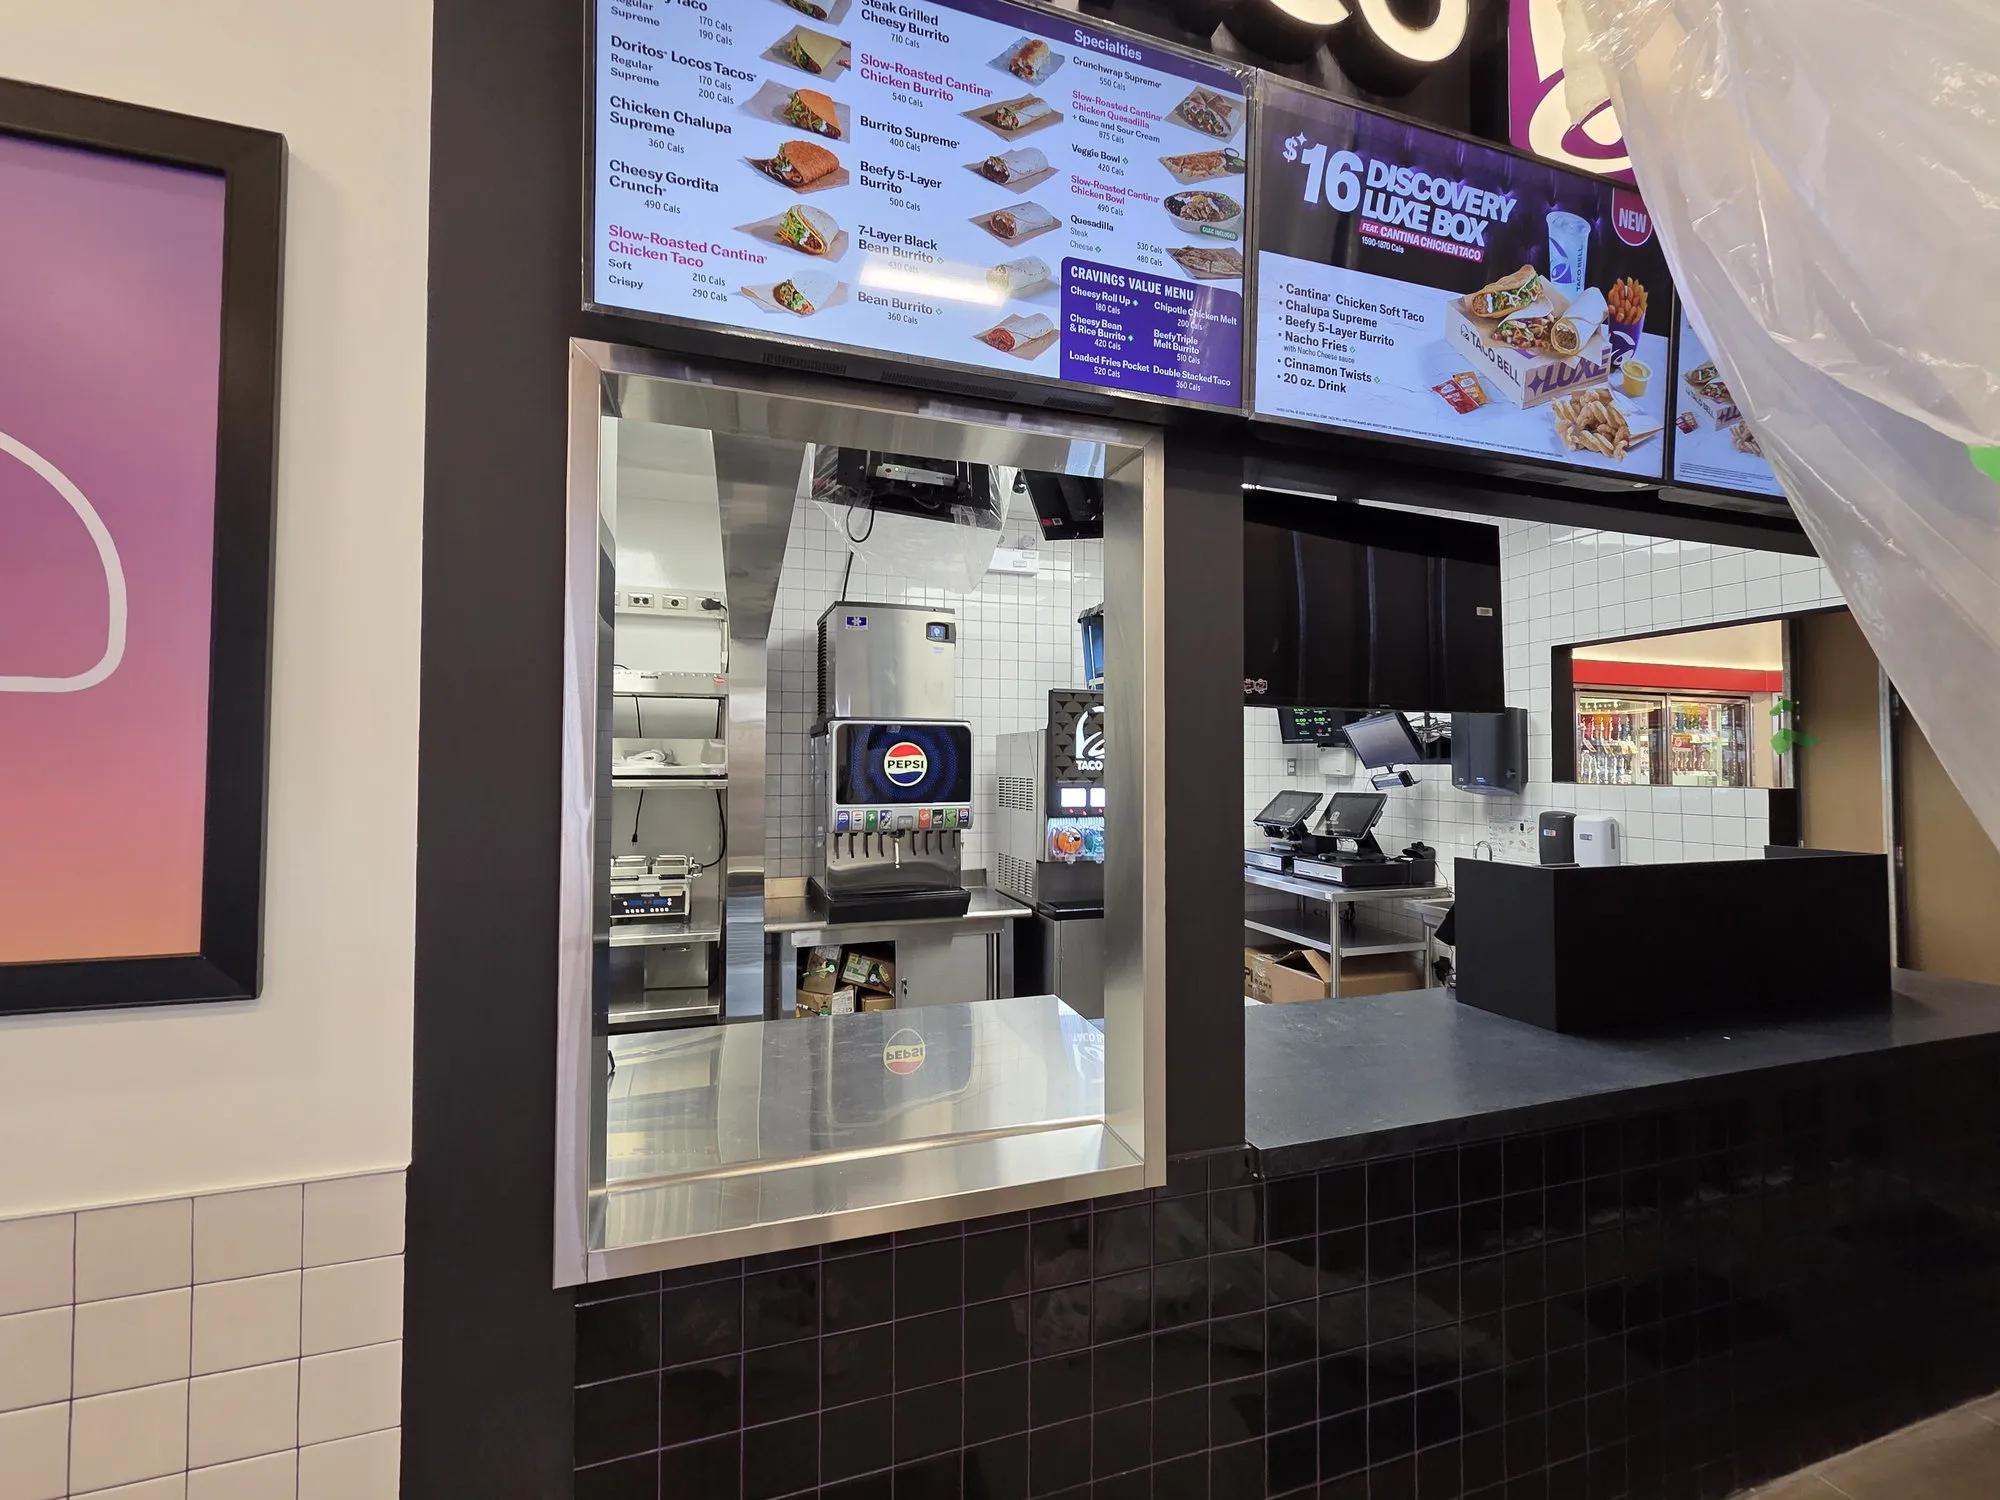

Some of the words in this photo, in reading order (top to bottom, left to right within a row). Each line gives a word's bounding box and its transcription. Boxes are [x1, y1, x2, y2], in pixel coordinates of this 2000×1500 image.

[611, 6, 660, 27] Supreme
[861, 0, 897, 14] Steak
[899, 6, 939, 26] Grilled
[700, 16, 713, 27] 170
[715, 21, 732, 32] Cals
[862, 9, 906, 32] Cheesy
[909, 22, 949, 43] Burrito
[700, 30, 713, 40] 190
[716, 34, 733, 46] Cals
[891, 33, 903, 43] 710
[905, 38, 920, 48] Cals
[1074, 29, 1142, 61] Specialties
[611, 53, 653, 72] Regular
[672, 51, 712, 71] Locos
[861, 53, 943, 85] Slow-Roasted
[1073, 56, 1123, 79] Crunchwrap
[611, 67, 659, 87] Supreme
[699, 76, 712, 87] 170
[715, 80, 732, 91] Cals
[861, 68, 909, 90] Chicken
[913, 82, 954, 102] Burrito
[699, 88, 714, 99] 200
[718, 94, 734, 105] Cals
[893, 93, 906, 103] 540
[909, 97, 923, 108] Cals
[1072, 91, 1128, 113] Slow-Roasted
[610, 95, 669, 120] Chicken
[674, 110, 732, 134] Chalupa
[610, 111, 675, 136] Supreme
[1072, 102, 1106, 118] Chicken
[1107, 111, 1150, 129] Quesadilla
[861, 116, 902, 135] Burrito
[1079, 115, 1099, 127] Guac
[1101, 120, 1115, 130] and
[1117, 125, 1134, 137] Sour
[1136, 130, 1160, 144] Cream
[648, 138, 665, 149] 360
[668, 143, 684, 154] Cals
[890, 138, 904, 148] 400
[906, 142, 920, 152] Cals
[1072, 144, 1099, 159] Veggie
[1101, 151, 1120, 164] Bowl
[610, 160, 663, 182] Cheesy
[666, 172, 719, 193] Gordita
[861, 161, 895, 180] Beefy
[898, 170, 942, 189] 5-Layer
[861, 175, 902, 193] Burrito
[1071, 175, 1126, 195] Slow-Roasted
[1071, 186, 1105, 200] Chicken
[1106, 193, 1125, 205] Bowl
[1367, 159, 1517, 223] DISCOVERY
[644, 200, 660, 210] 490
[664, 204, 680, 214] Cals
[890, 198, 903, 208] 500
[906, 202, 920, 212] Cals
[1071, 215, 1114, 232] Quesadilla
[1362, 190, 1430, 232] LUXE
[1432, 208, 1488, 247] BOX
[1619, 208, 1646, 233] NEW
[609, 225, 707, 254] Slow-Roasted
[858, 225, 902, 243] 7-Layer
[905, 234, 937, 250] Black
[1070, 228, 1088, 238] Steak
[1362, 223, 1378, 234] FEAT.
[1381, 227, 1421, 246] CANTINA
[1421, 235, 1459, 255] CHICKEN
[1459, 246, 1481, 261] TACO
[609, 241, 668, 261] Chicken
[671, 251, 704, 268] Taco
[858, 239, 889, 255] Bean
[893, 246, 933, 263] Burrito
[1070, 240, 1093, 251] Cheese
[1362, 236, 1390, 251] 1590-1870
[1392, 244, 1404, 254] Cals
[608, 259, 632, 270] Soft
[609, 275, 643, 289] Crispy
[693, 273, 706, 283] 210
[709, 277, 725, 286] Cals
[1071, 266, 1125, 287] CRAVINGS
[1129, 278, 1161, 295] VALUE
[1165, 285, 1194, 301] MENU
[693, 289, 708, 299] 290
[711, 292, 728, 302] Cals
[858, 292, 888, 306] Bean
[892, 298, 933, 315] Burrito
[1071, 285, 1101, 301] Cheesy
[1102, 292, 1118, 302] Roll
[1119, 295, 1131, 306] Up
[888, 312, 901, 322] 360
[904, 315, 918, 324] Cals
[1154, 302, 1187, 316] Chipotle
[1188, 309, 1219, 322] Chicken
[1221, 314, 1237, 325] Melt
[1286, 300, 1329, 318] Chalupa
[1333, 309, 1377, 328] Supreme
[1336, 294, 1377, 312] Chicken
[1380, 304, 1401, 318] Soft
[1402, 309, 1425, 323] Taco
[1070, 314, 1101, 328] Cheesy
[1102, 319, 1122, 331] Bean
[1070, 324, 1076, 332] &
[1078, 326, 1096, 336] Rice
[1098, 329, 1126, 341] Burrito
[1285, 315, 1316, 332] Beefy
[1319, 322, 1357, 339] 5-Layer
[1360, 330, 1395, 347] Burrito
[1154, 330, 1177, 342] Beefy
[1177, 335, 1198, 345] Triple
[1154, 339, 1172, 350] Melt
[1173, 343, 1199, 355] Burrito
[1285, 331, 1319, 347] Nacho
[1322, 338, 1347, 353] Fries
[1069, 351, 1099, 365] Loaded
[1101, 357, 1121, 368] Fries
[1123, 360, 1150, 373] Pocket
[1284, 345, 1297, 353] with
[1298, 347, 1316, 357] Nacho
[1317, 350, 1338, 361] Cheese
[1339, 355, 1355, 364] sauce
[1470, 331, 1496, 363] TACO
[1496, 354, 1521, 387] BELL
[1153, 366, 1181, 378] Double
[1182, 371, 1212, 383] Stacked
[1213, 376, 1231, 387] Taco
[1285, 357, 1338, 377] Cinnamon
[1340, 367, 1372, 383] Twists
[1543, 347, 1611, 394] LUXE
[1284, 373, 1298, 384] 20
[1300, 378, 1315, 387] oz.
[1318, 379, 1347, 393] Drink
[888, 760, 924, 769] PEPSI
[1076, 760, 1104, 771] TACO
